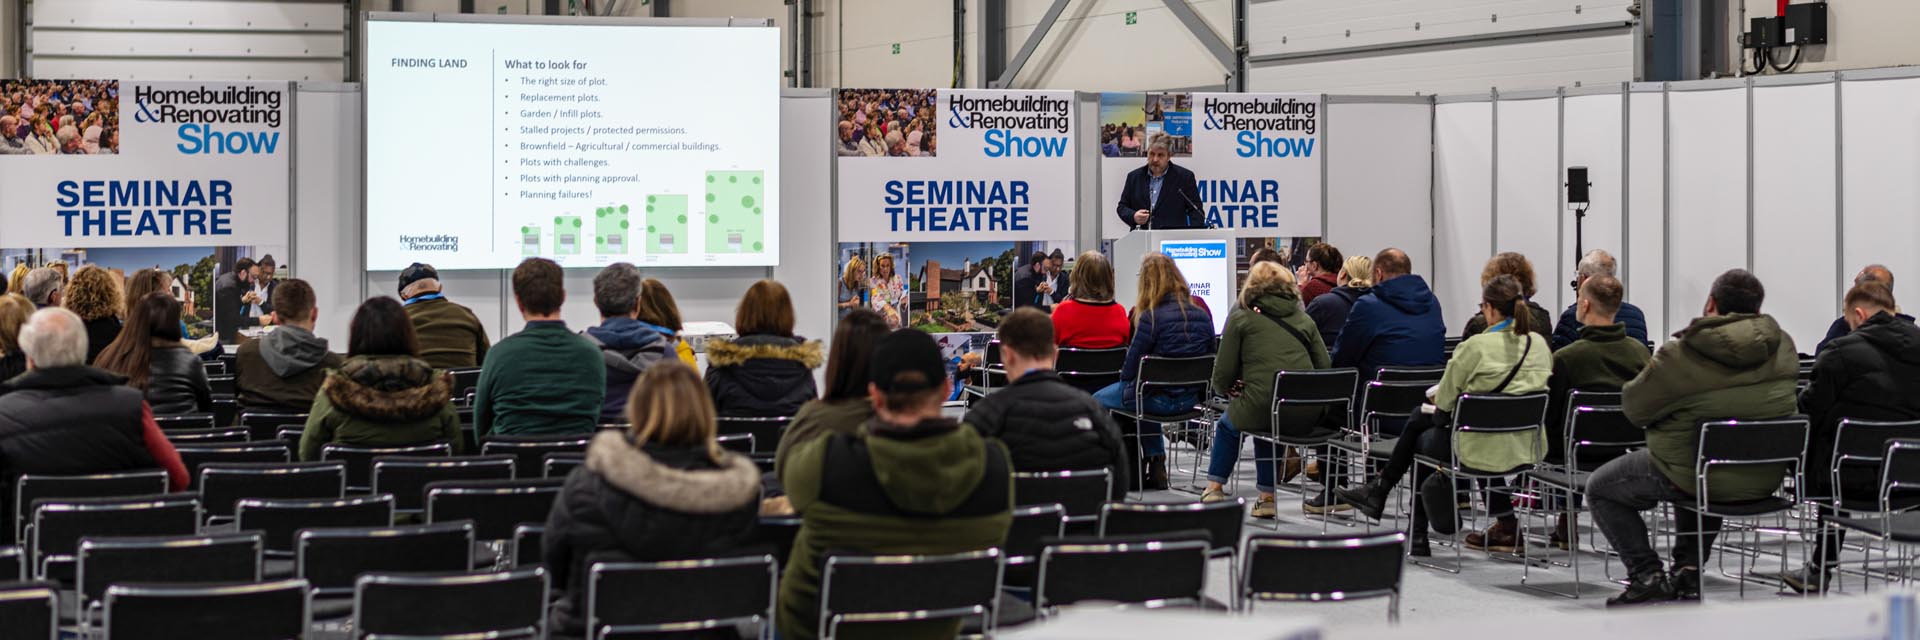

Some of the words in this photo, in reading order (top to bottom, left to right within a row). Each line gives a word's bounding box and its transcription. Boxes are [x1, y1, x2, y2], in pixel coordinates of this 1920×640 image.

[391, 58, 437, 69] FINDING
[438, 59, 468, 69] LAND
[504, 59, 533, 70] What
[534, 60, 547, 70] to
[548, 60, 571, 70] look
[572, 60, 588, 70] for
[520, 76, 537, 86] The
[538, 77, 559, 88] right
[560, 77, 576, 86] size
[577, 77, 588, 86] of
[588, 77, 608, 88] plot.
[134, 85, 281, 109] Homebuilding
[520, 92, 576, 103] Replacement
[577, 93, 601, 103] plots.
[949, 95, 1069, 117] Homebuilding
[1204, 98, 1316, 119] Homebuilding
[520, 109, 552, 119] Garden
[560, 109, 579, 119] Infill
[580, 110, 603, 120] plots.
[520, 125, 550, 135] Stalled
[550, 125, 586, 136] projects
[593, 126, 634, 137] protected
[635, 126, 688, 137] permissions.
[176, 124, 280, 155] Show
[983, 129, 1068, 158] Show
[1236, 130, 1315, 158] Show
[520, 141, 567, 151] Brownfield
[576, 142, 624, 153] Agricultural
[631, 142, 681, 152] commercial
[682, 142, 722, 153] buildings.
[520, 157, 542, 167] Plots
[542, 158, 563, 167] with
[564, 157, 610, 168] challenges.
[520, 173, 542, 183] Plots
[542, 174, 562, 183] with
[563, 174, 601, 185] planning
[601, 174, 641, 185] approval.
[56, 180, 233, 207] SEMINAR
[520, 190, 557, 201] Planning
[558, 190, 593, 200] failures!
[884, 180, 1030, 205] SEMINAR
[56, 209, 233, 236] THEATRE
[884, 207, 1029, 232] THEATRE
[400, 234, 459, 244] Homebuilding
[1198, 247, 1222, 257] Show
